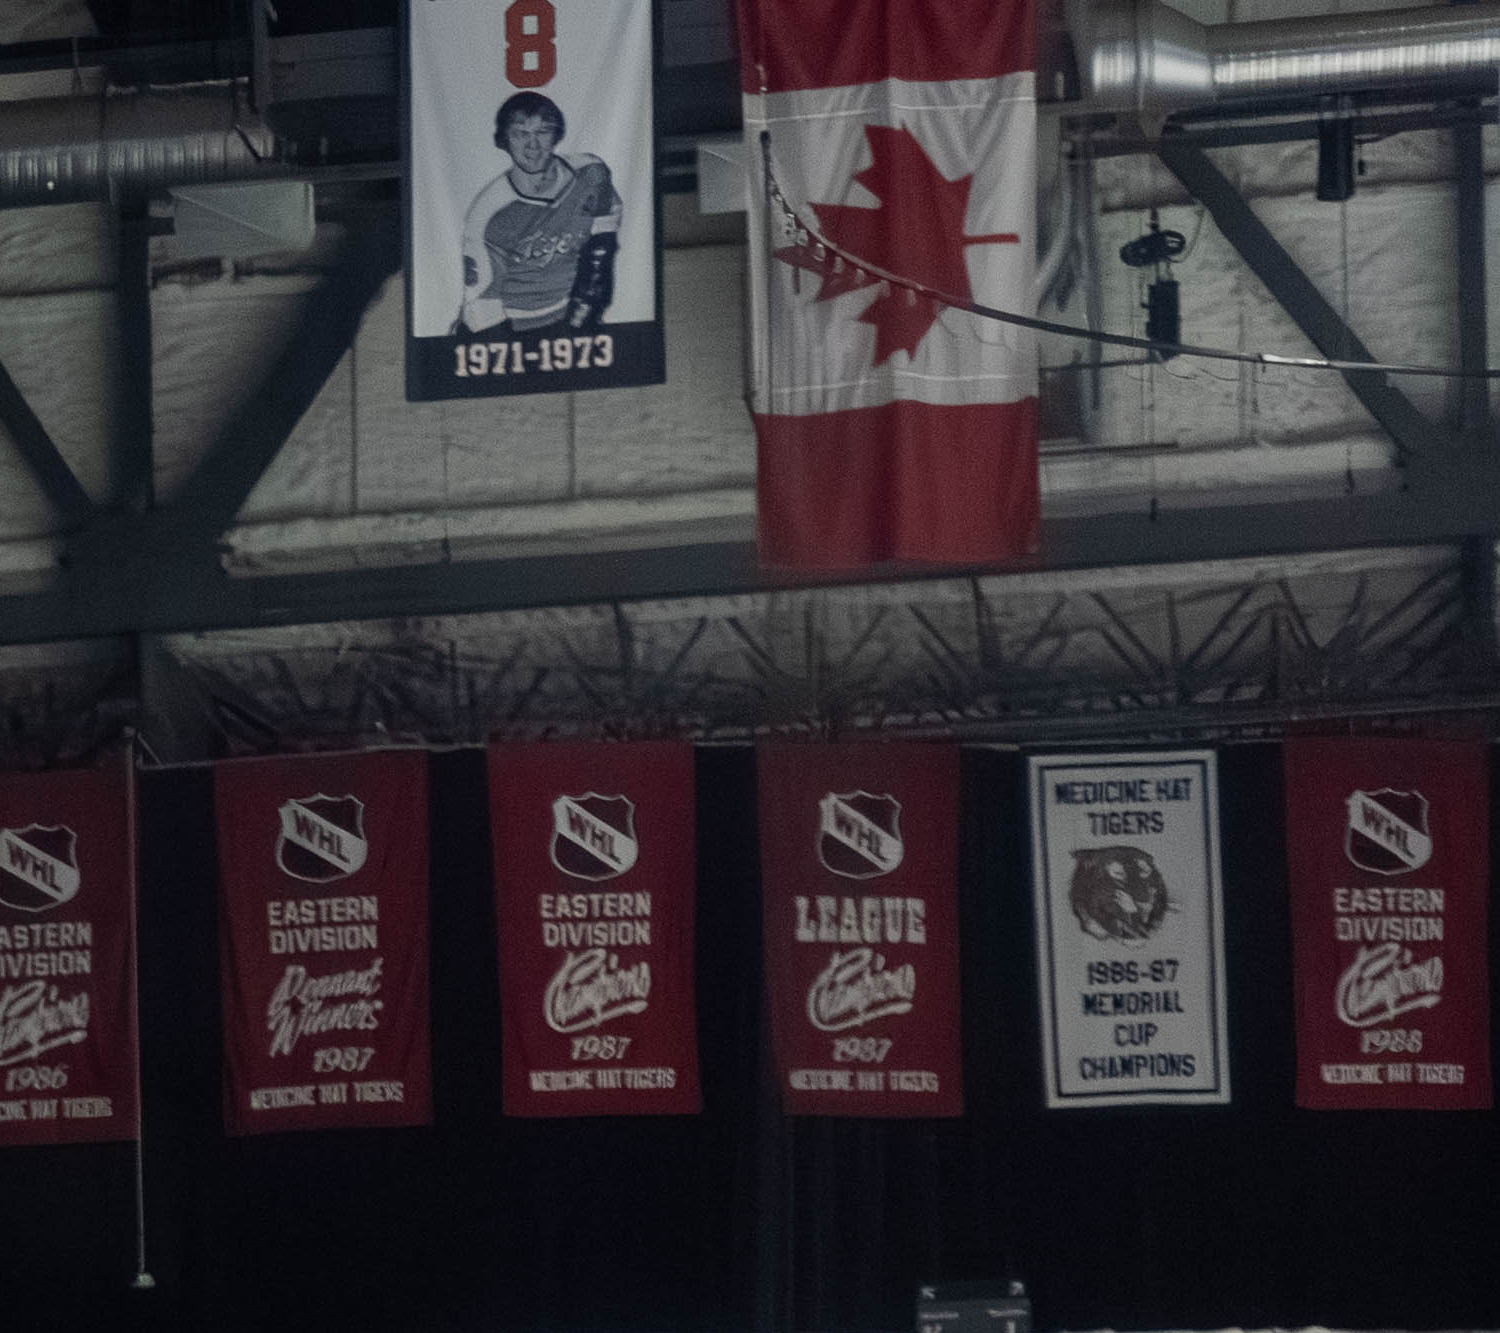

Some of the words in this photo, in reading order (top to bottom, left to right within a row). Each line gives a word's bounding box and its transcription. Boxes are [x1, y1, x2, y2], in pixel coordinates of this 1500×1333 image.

[504, 0, 557, 89] 8
[453, 335, 614, 379] 1971-1973
[1055, 779, 1152, 805] MEDICINE
[1155, 776, 1193, 802] HAT
[1088, 810, 1165, 837] TIGERS
[4, 840, 65, 894] WHL
[266, 896, 379, 926] EASTERN
[540, 891, 652, 920] EASTERN
[1333, 887, 1445, 914] EASTERN
[542, 920, 652, 948] DIVISION
[794, 895, 927, 945] LEAGUE
[1335, 917, 1444, 942] DIVISION
[269, 924, 378, 954] DIVISION
[1080, 991, 1185, 1019] MEMORIAL
[1113, 1022, 1159, 1048] CUP
[1079, 1052, 1196, 1082] CHAMPIONS
